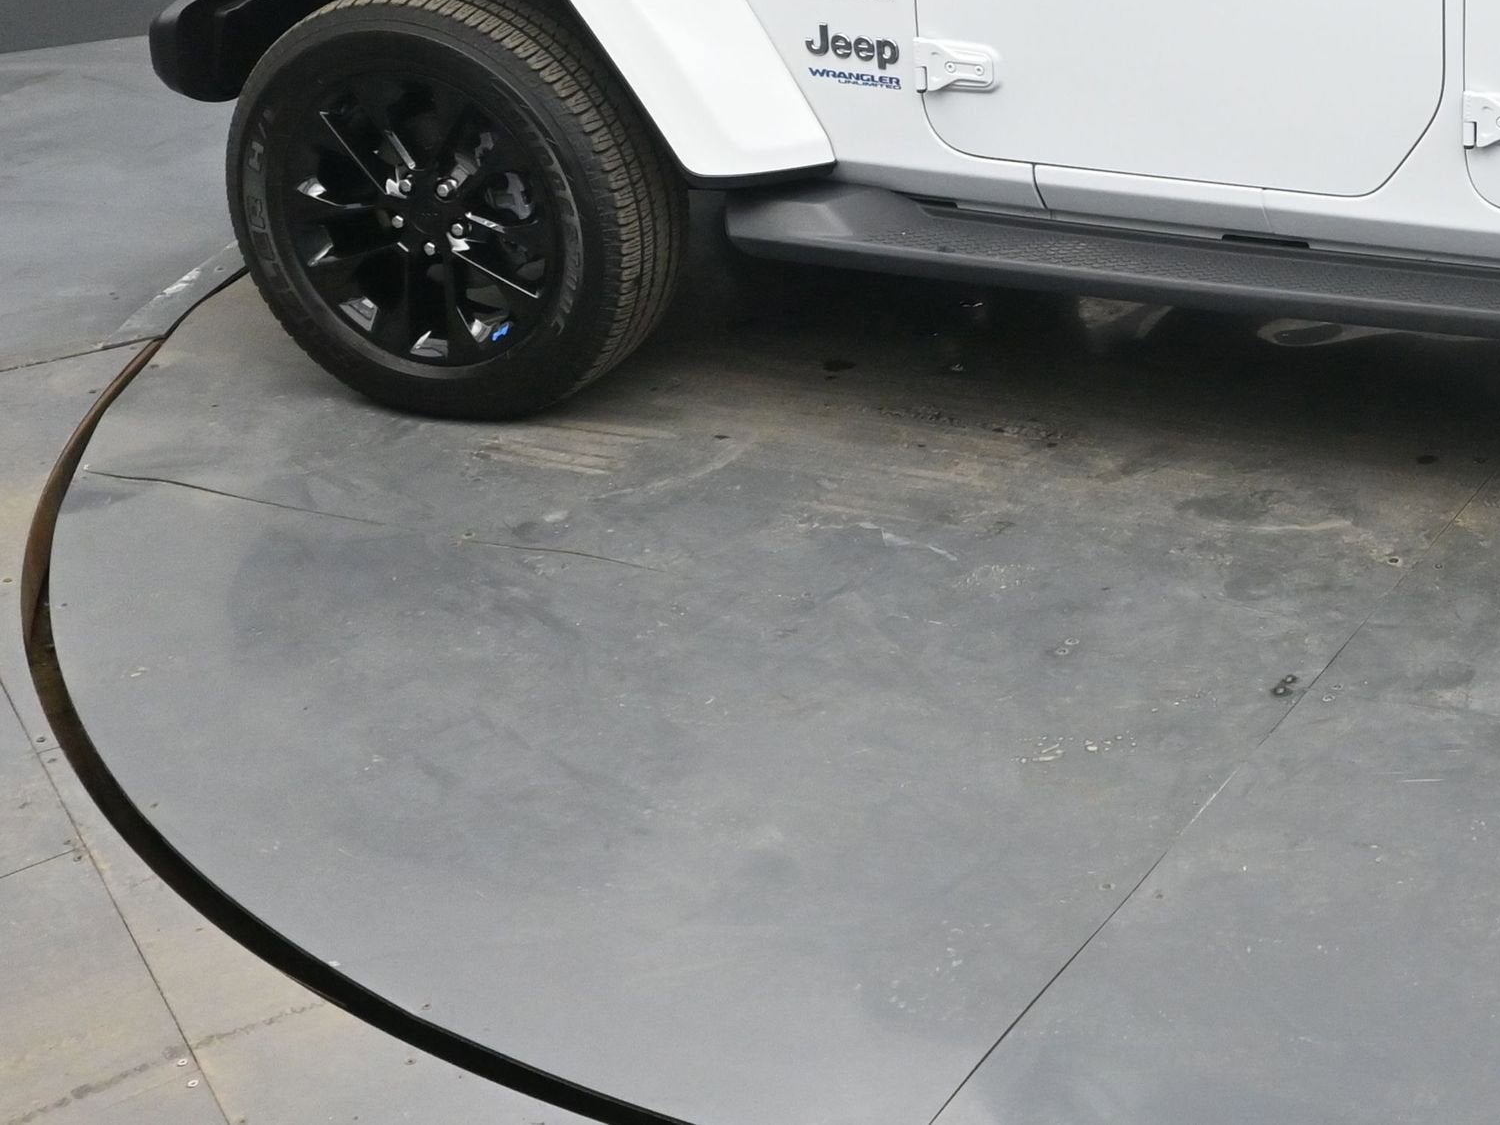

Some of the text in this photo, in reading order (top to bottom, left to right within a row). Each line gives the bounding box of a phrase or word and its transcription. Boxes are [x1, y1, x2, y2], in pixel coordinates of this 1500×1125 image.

[805, 22, 900, 70] Jeep
[808, 66, 901, 86] WRANGLER
[837, 78, 902, 90] UNLIMITED
